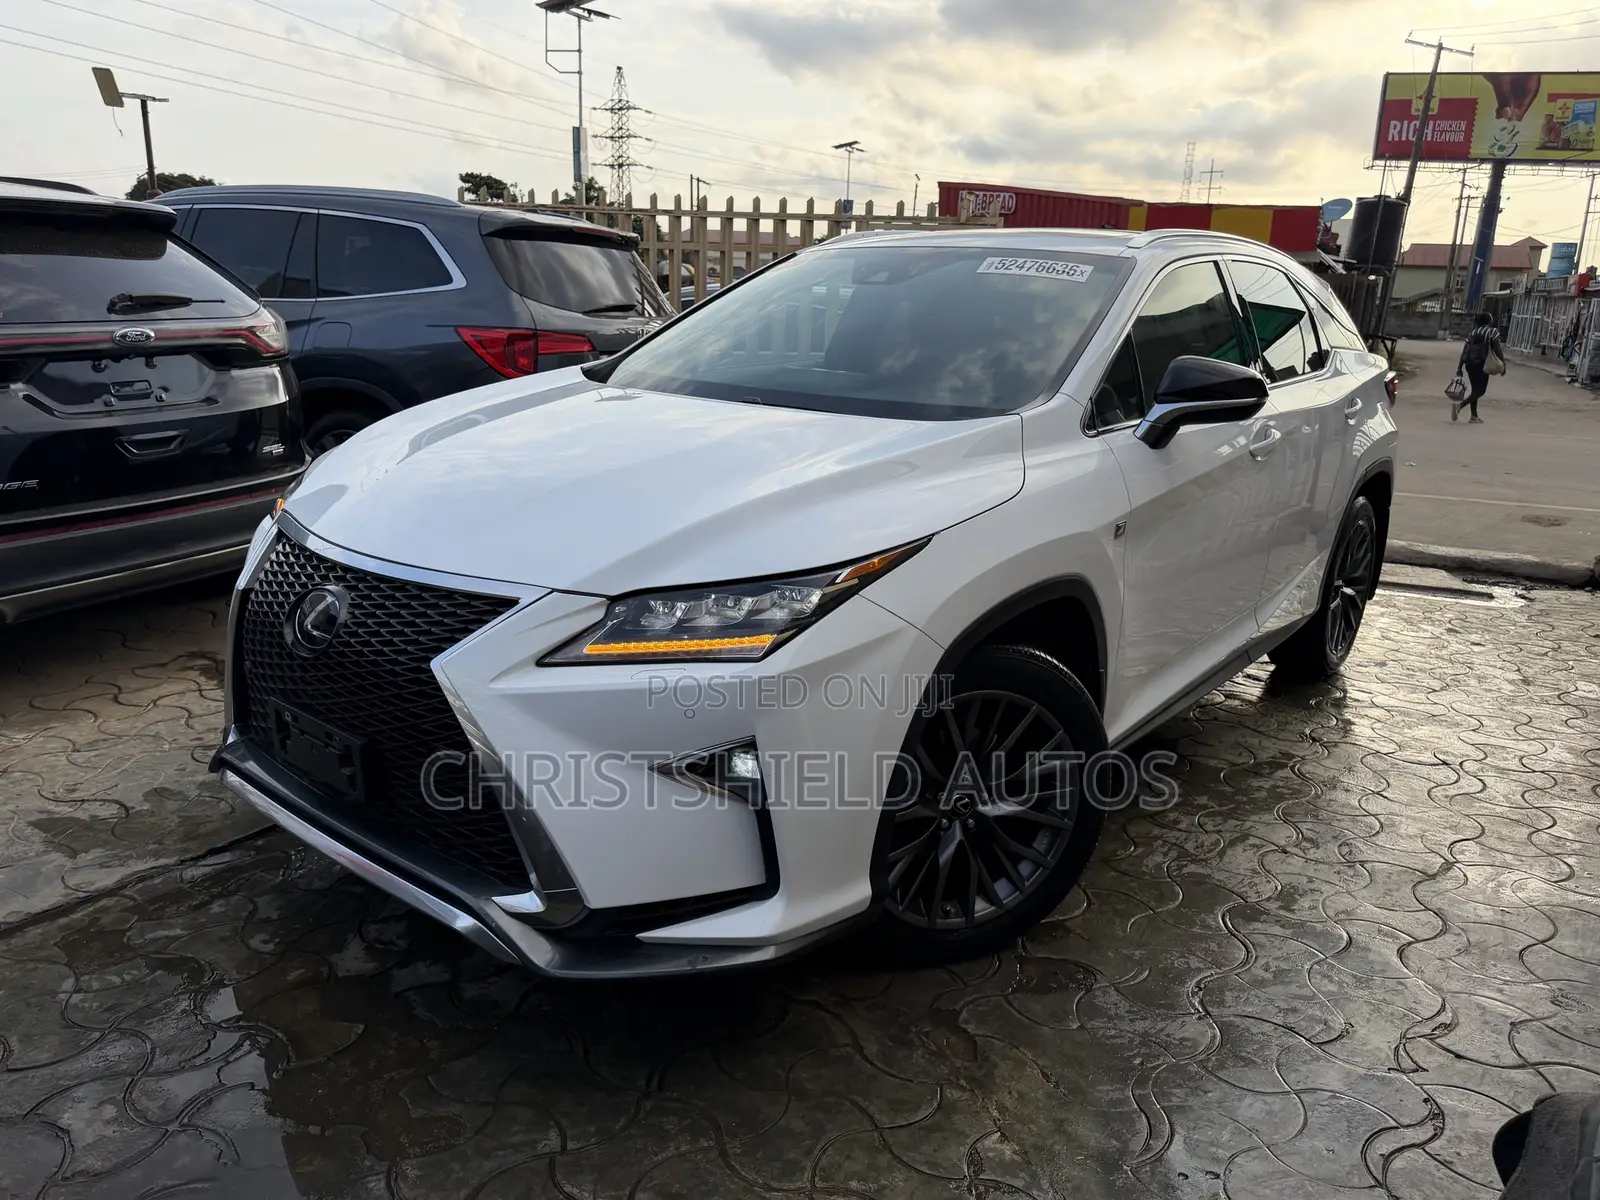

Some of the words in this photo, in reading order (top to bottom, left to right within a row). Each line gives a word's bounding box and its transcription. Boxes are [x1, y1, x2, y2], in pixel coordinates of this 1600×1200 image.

[1388, 120, 1434, 141] RICH
[1435, 120, 1467, 131] CHICKEN
[1433, 131, 1465, 142] FLAVOUR
[126, 331, 147, 342] Ford
[0, 479, 39, 490] GE
